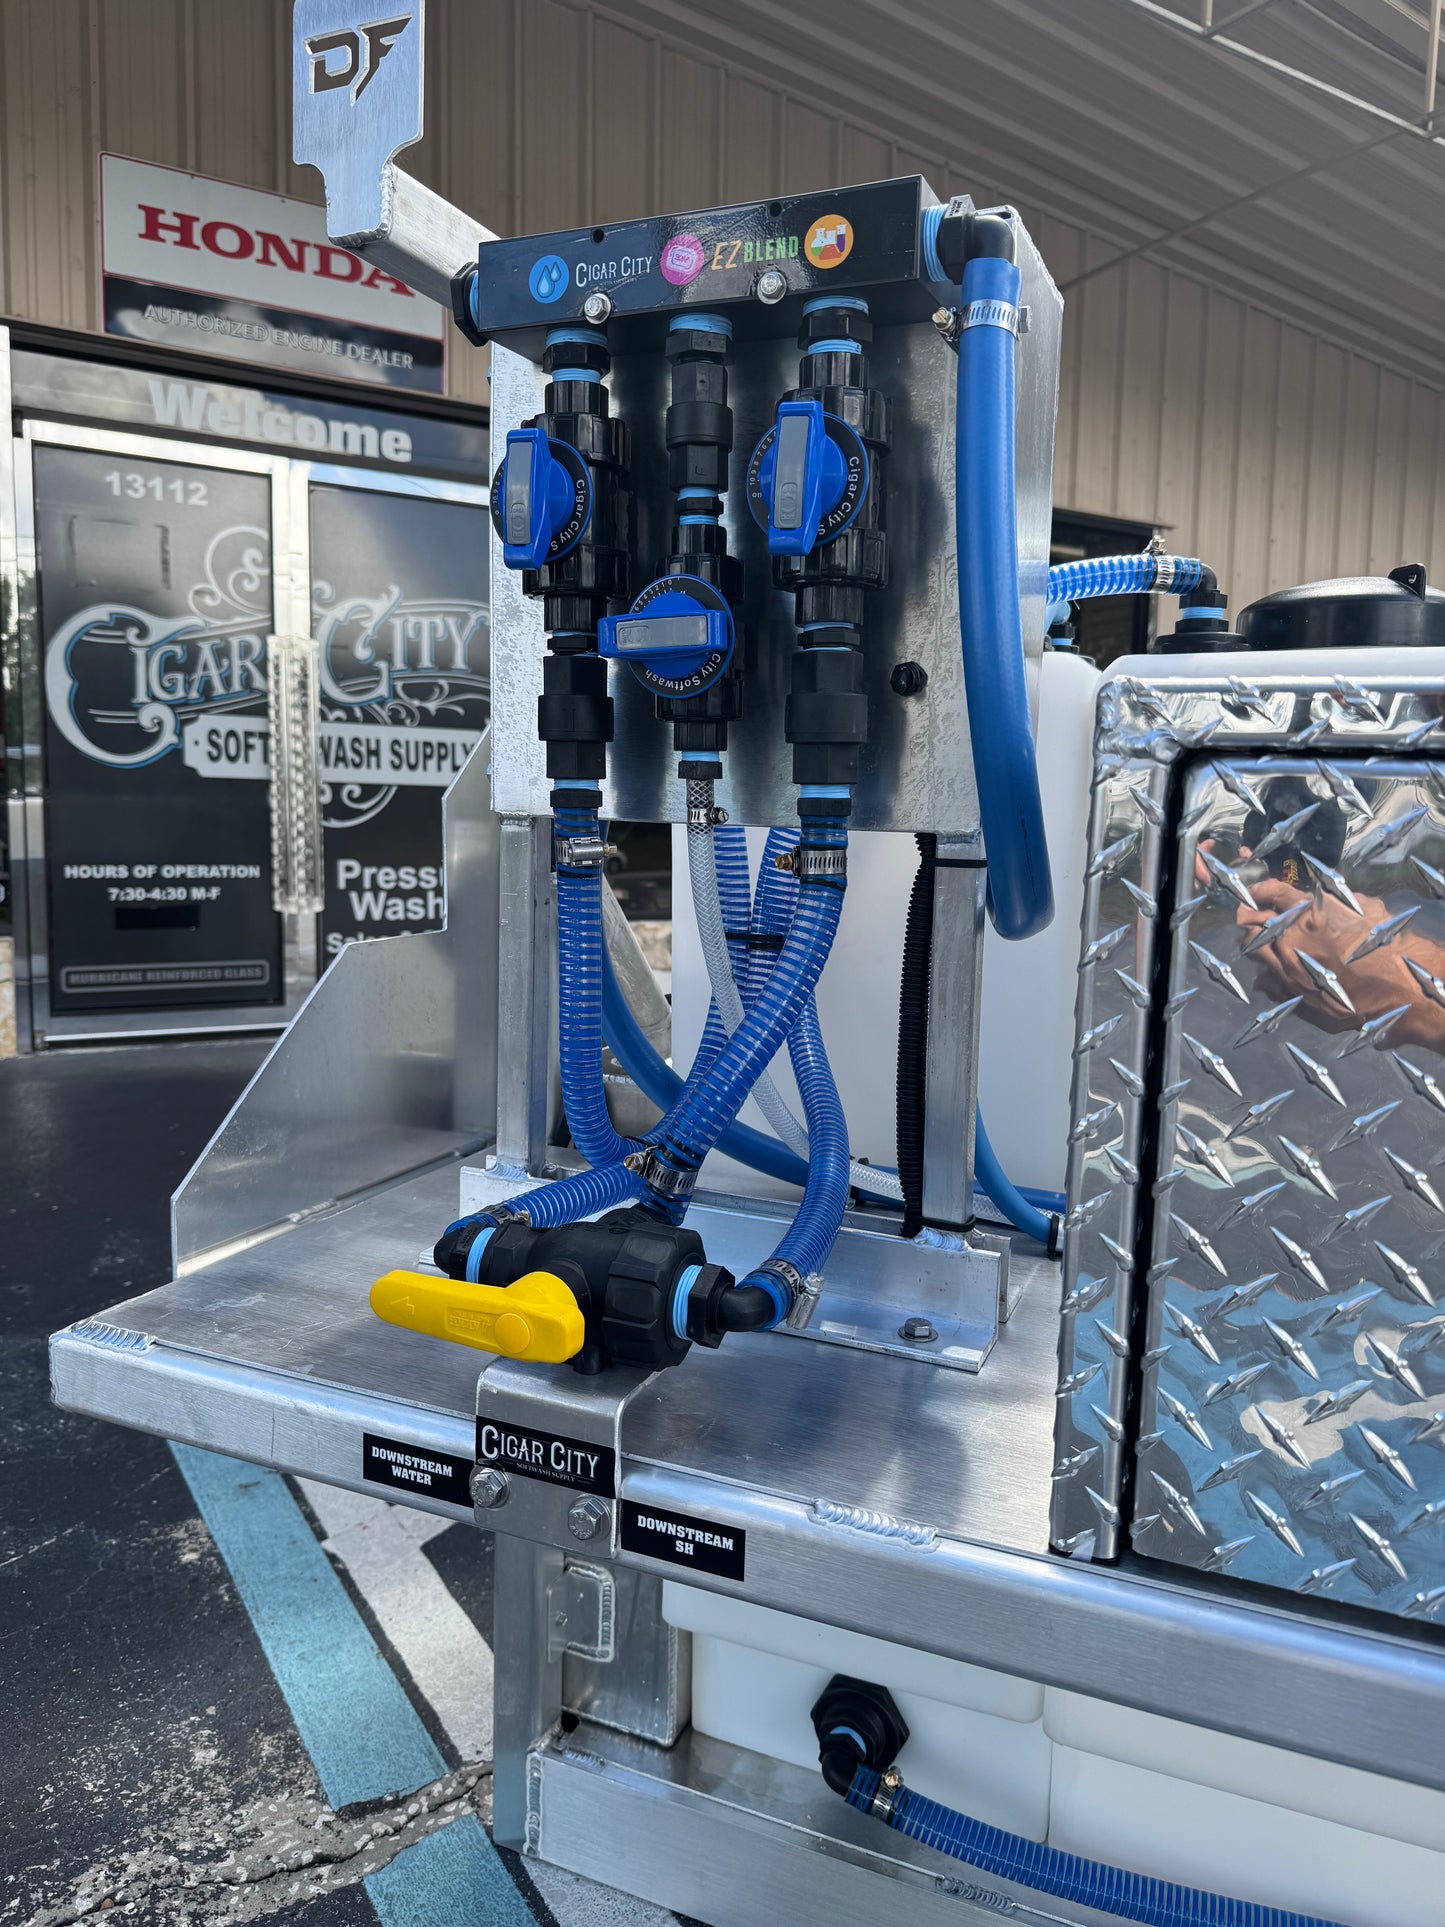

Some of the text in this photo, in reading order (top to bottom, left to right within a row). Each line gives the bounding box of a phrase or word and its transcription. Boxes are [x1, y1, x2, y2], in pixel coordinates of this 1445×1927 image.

[137, 203, 416, 297] HONDA
[144, 304, 415, 369] AUTHORIZED ENGINE DEALER
[149, 380, 413, 463] Welcome
[105, 471, 209, 506] 13112
[828, 456, 861, 527] Cigar City
[560, 479, 586, 544] Cigar City
[645, 653, 722, 691] City Softwash
[64, 864, 261, 879] HOURS OF OPERATION
[337, 858, 444, 891] Press
[107, 887, 221, 901] 7:30-4:30 M-F
[371, 1446, 453, 1478] DOWNSTREAM
[391, 1464, 432, 1486] WATER
[516, 1462, 576, 1483] SOFTWASH SUPPLY
[637, 1514, 734, 1551] DOWNSTREAM
[675, 1540, 694, 1555] SH
